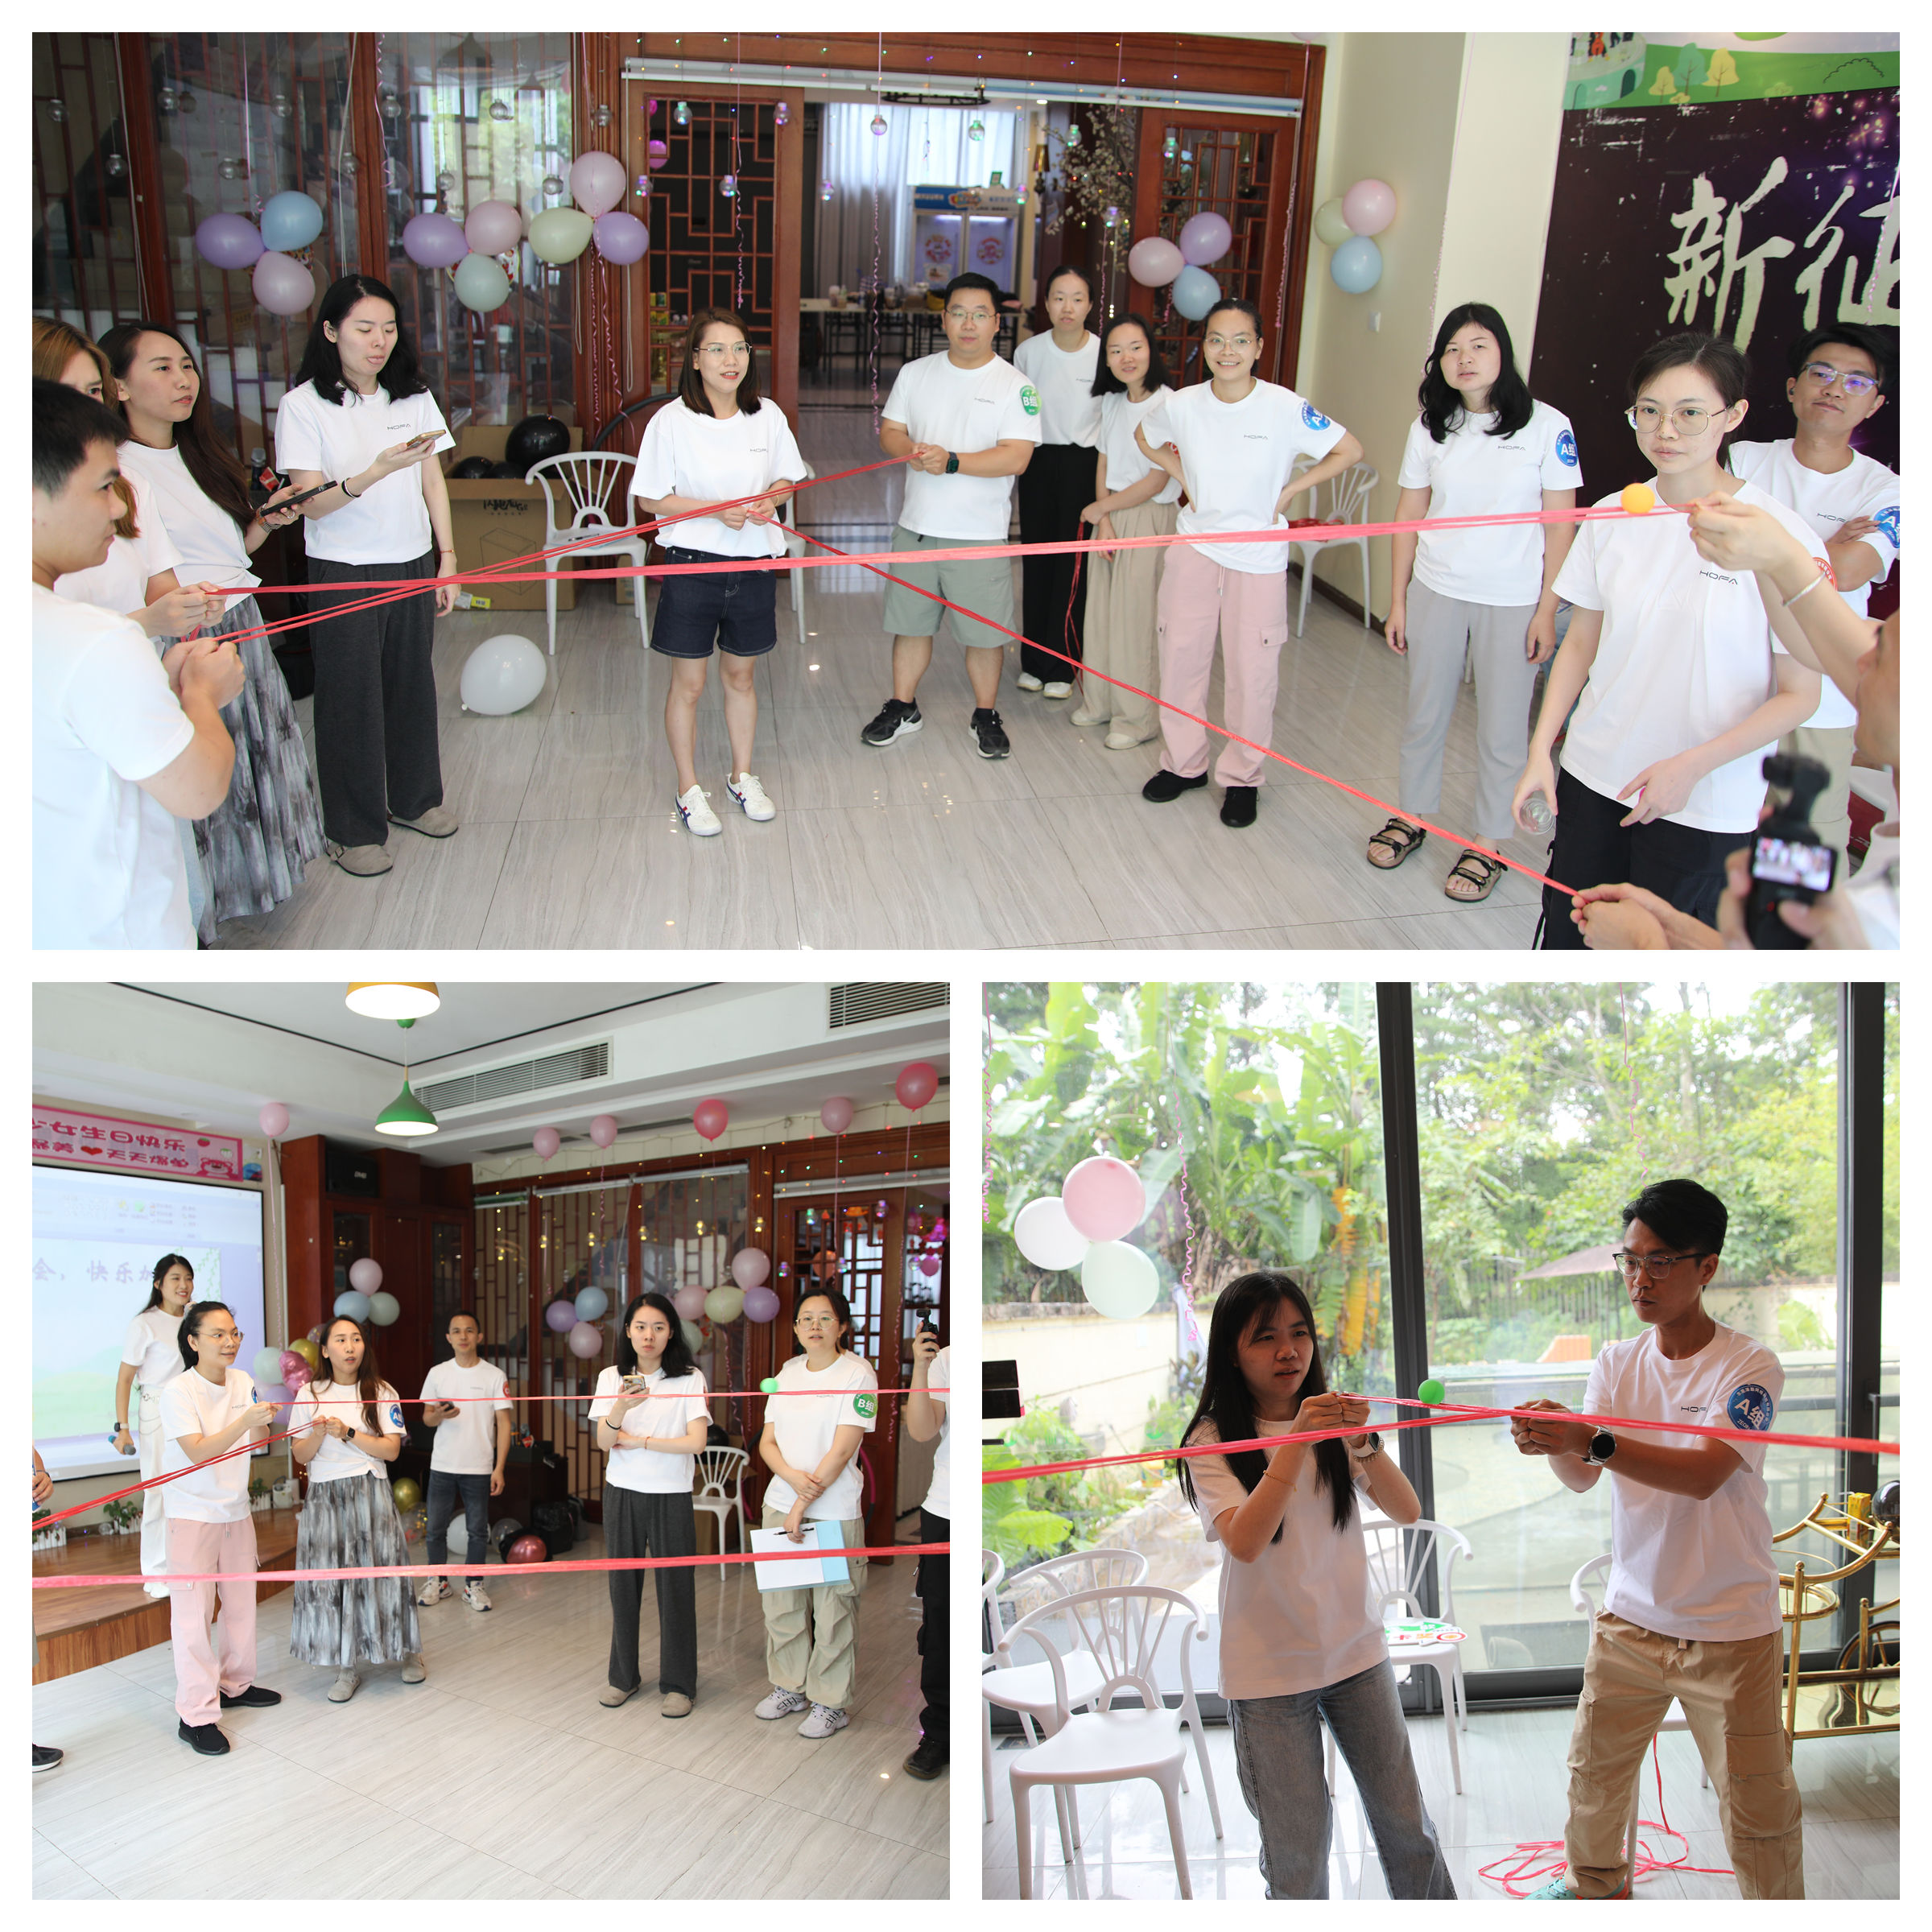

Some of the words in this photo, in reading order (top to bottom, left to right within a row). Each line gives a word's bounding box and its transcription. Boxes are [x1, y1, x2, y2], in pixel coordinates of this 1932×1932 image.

[1816, 512, 1846, 523] HOF
[1699, 569, 1738, 585] HOFA
[857, 1398, 875, 1413] B组
[1681, 1406, 1707, 1414] HOF
[1734, 1398, 1765, 1430] A组
